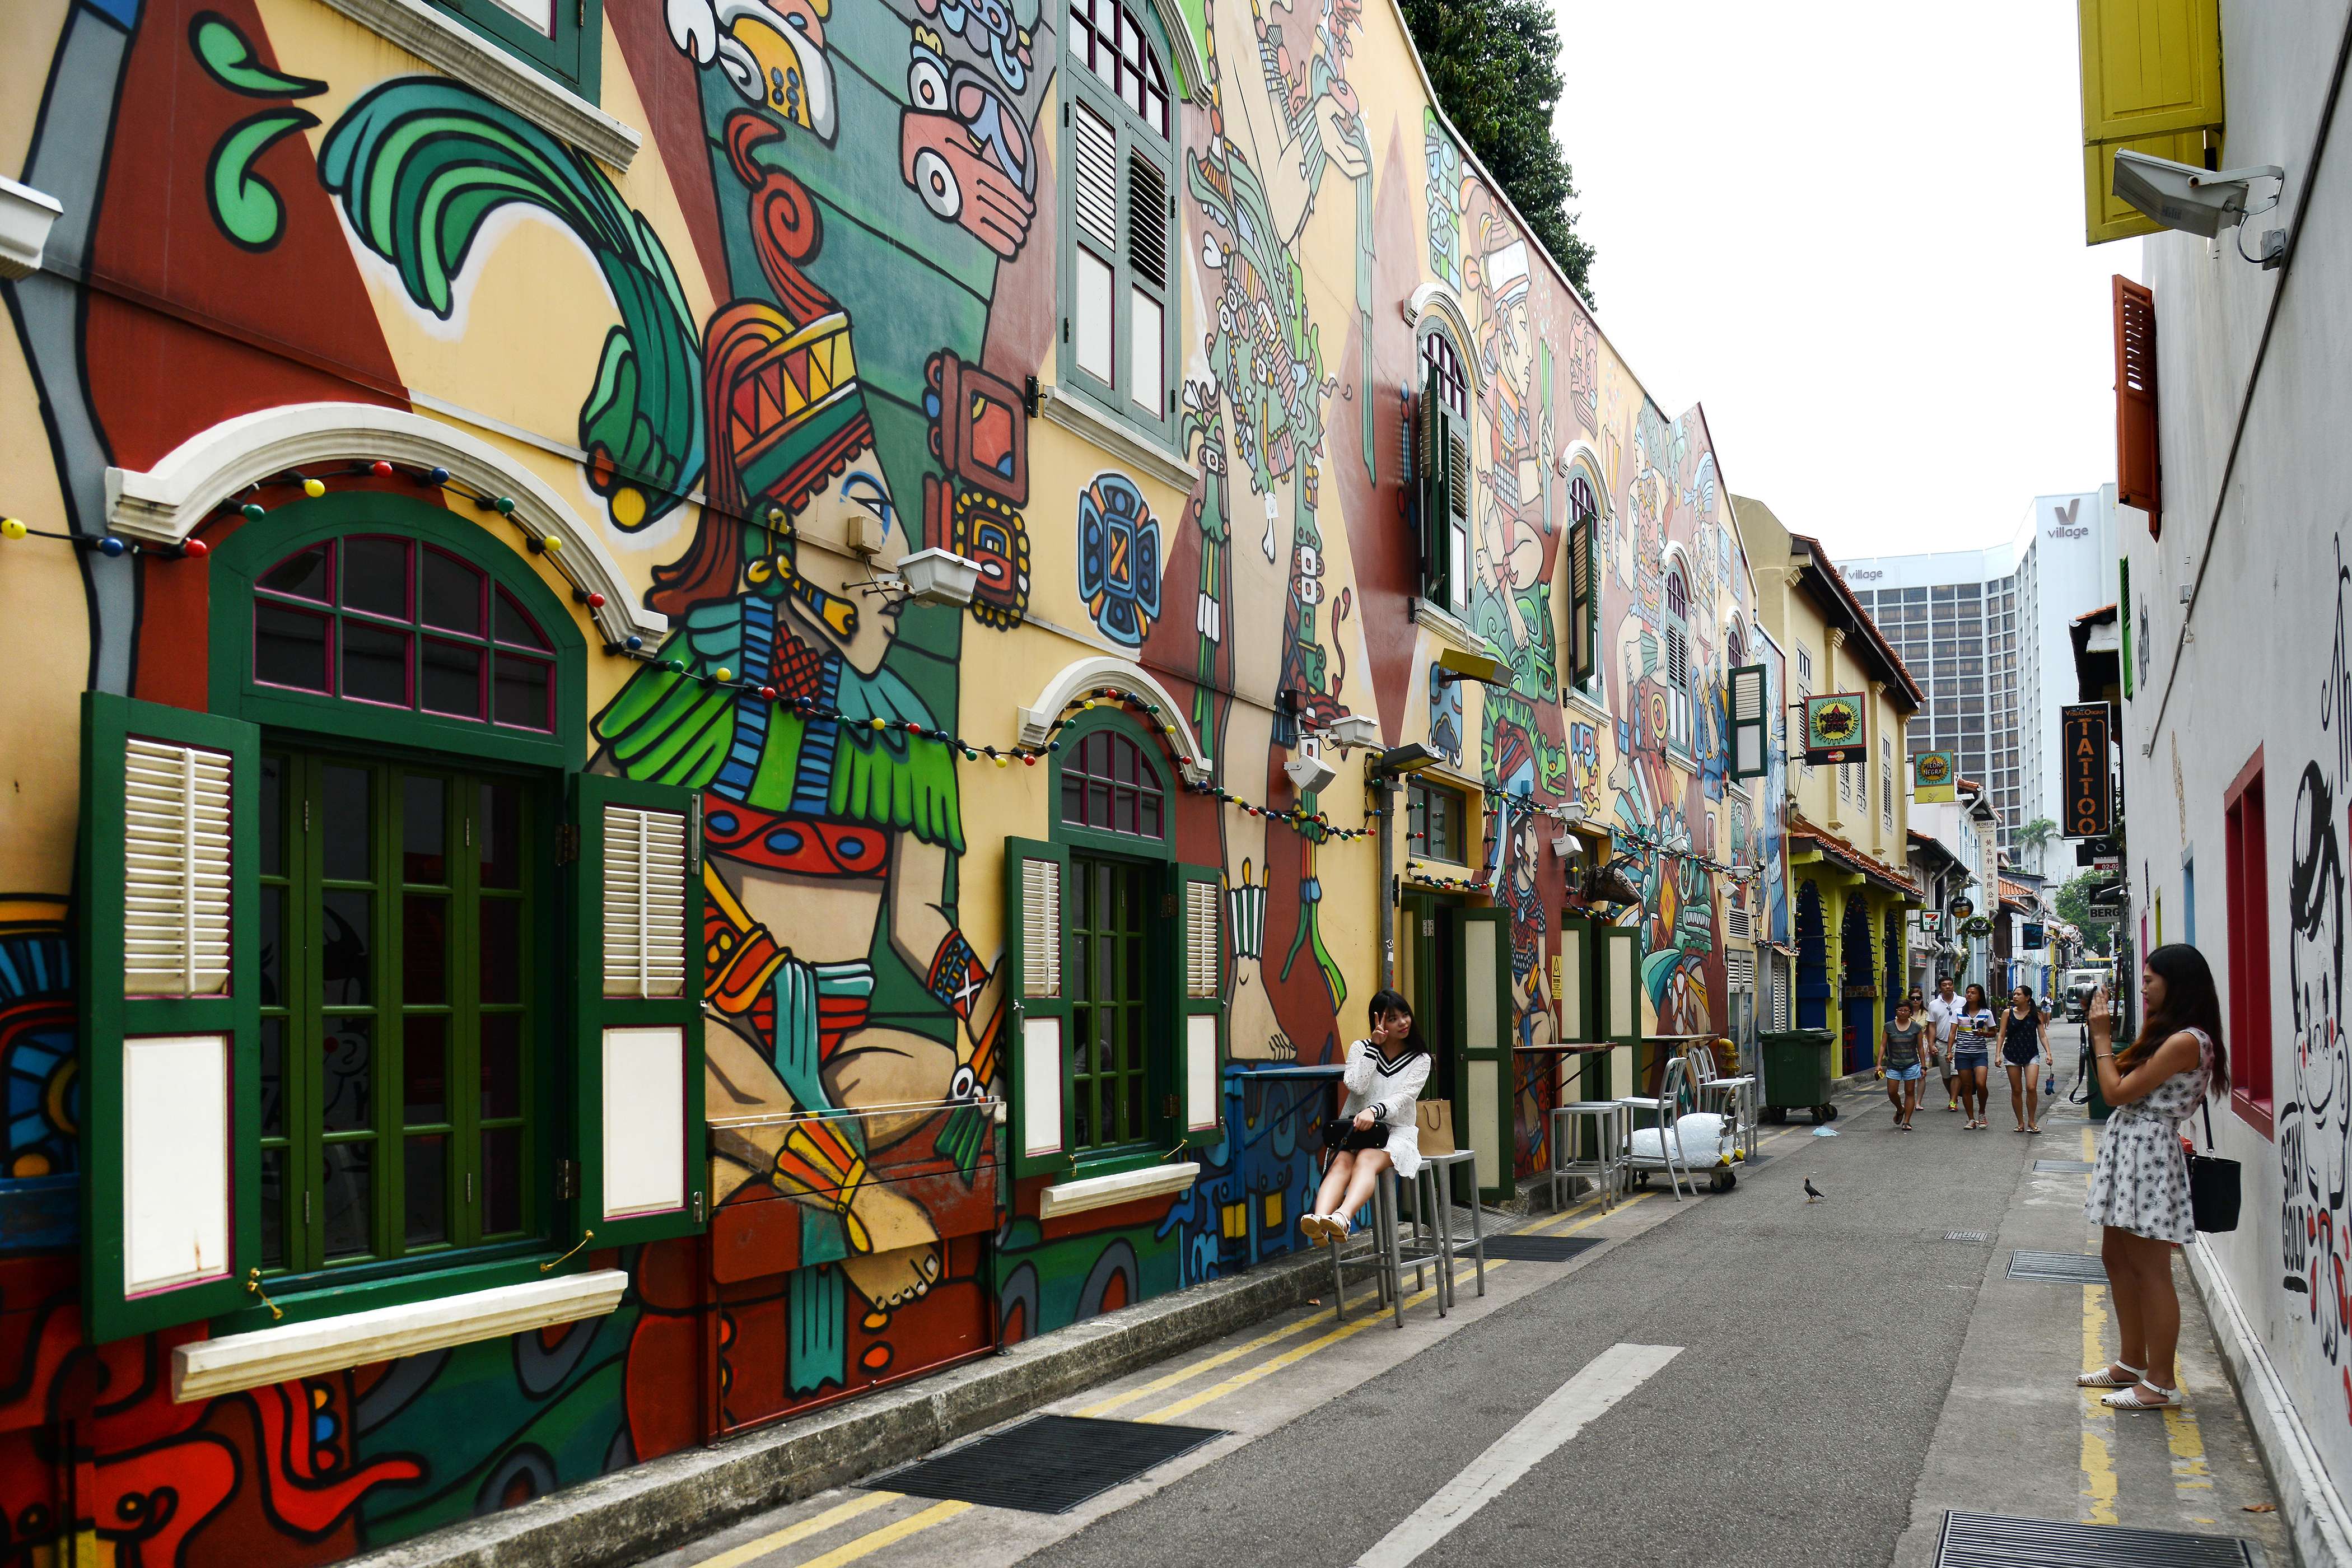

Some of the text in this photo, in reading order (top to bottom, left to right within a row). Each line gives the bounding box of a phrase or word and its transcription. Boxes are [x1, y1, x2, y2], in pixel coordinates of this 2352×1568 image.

[2047, 526, 2088, 539] village
[1848, 569, 1883, 581] village
[1819, 712, 1852, 723] PIEDRA
[2076, 718, 2096, 835] TATTOO
[2281, 1121, 2303, 1204] STAY
[2282, 1201, 2305, 1273] GOLD
